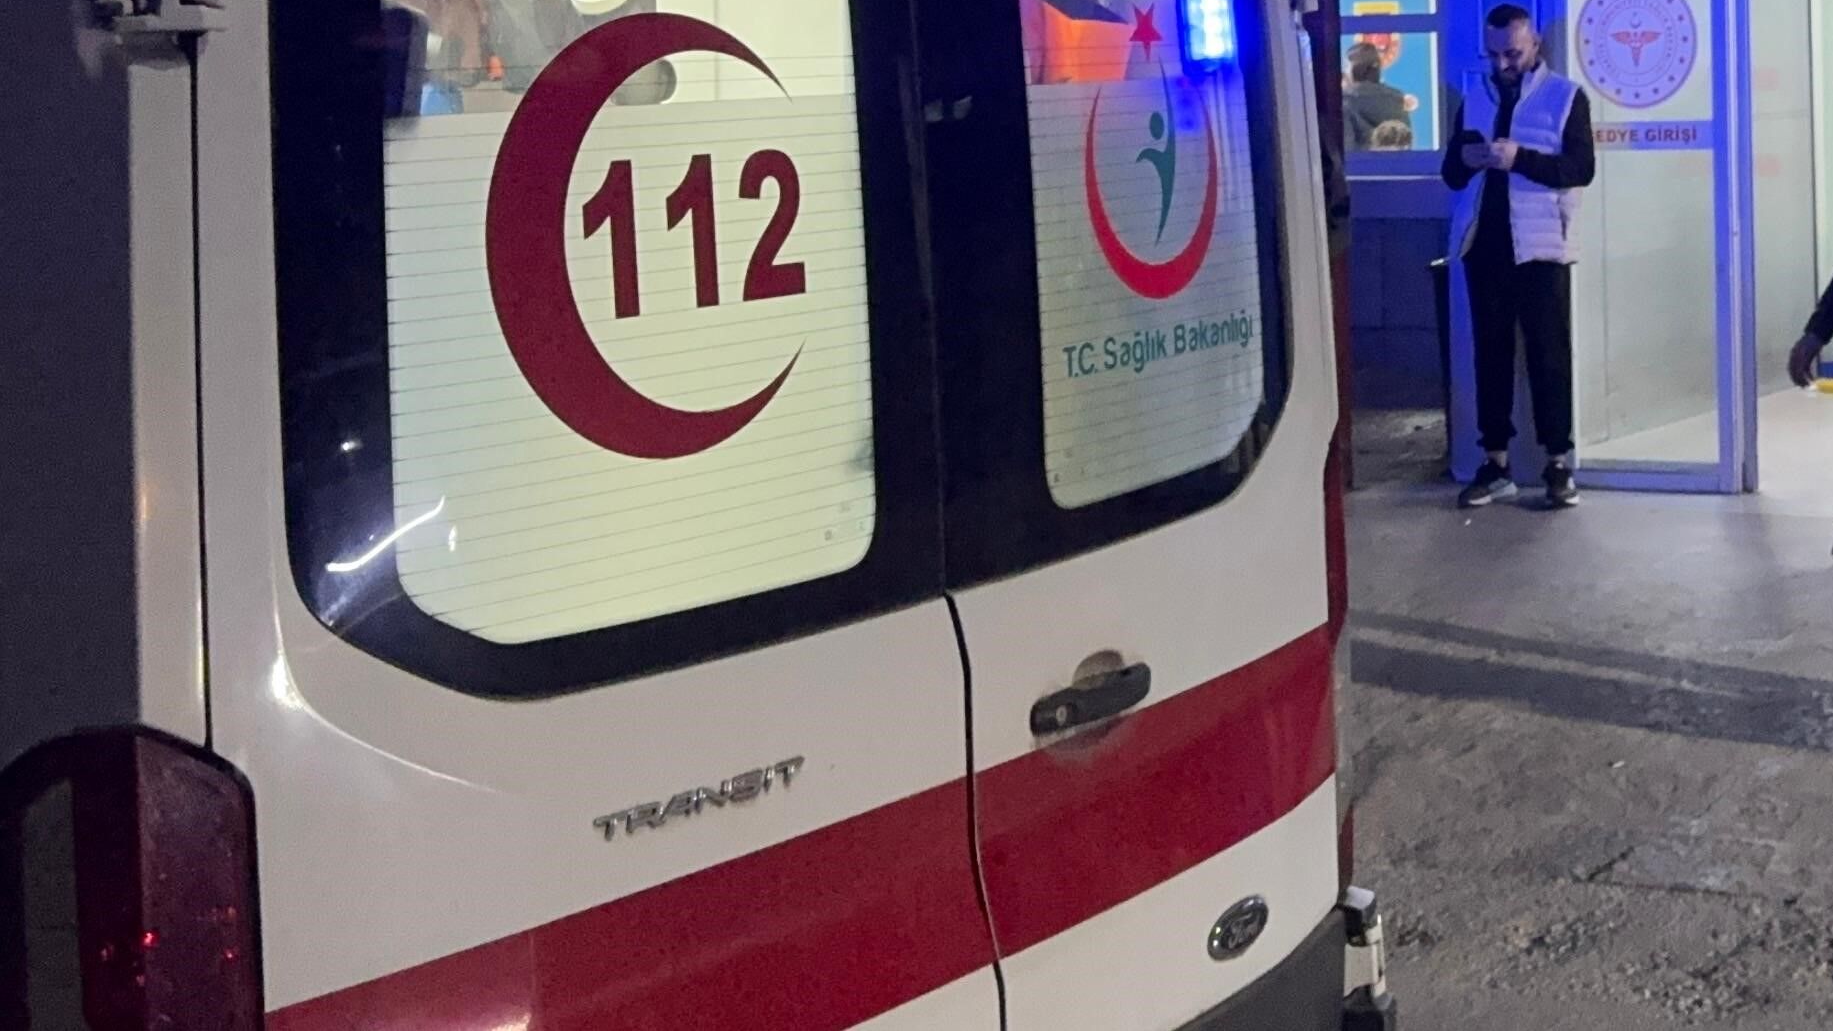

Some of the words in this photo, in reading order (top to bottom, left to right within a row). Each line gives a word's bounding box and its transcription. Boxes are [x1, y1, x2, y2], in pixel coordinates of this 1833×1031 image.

[1591, 128, 1639, 143] EDYE
[1644, 124, 1697, 145] GİRİŞİ
[582, 148, 807, 320] 112
[1062, 341, 1099, 378] T.C.
[1102, 329, 1168, 374] Sağlık
[1172, 308, 1254, 355] Bakanlığı
[592, 755, 806, 842] TRANSIT
